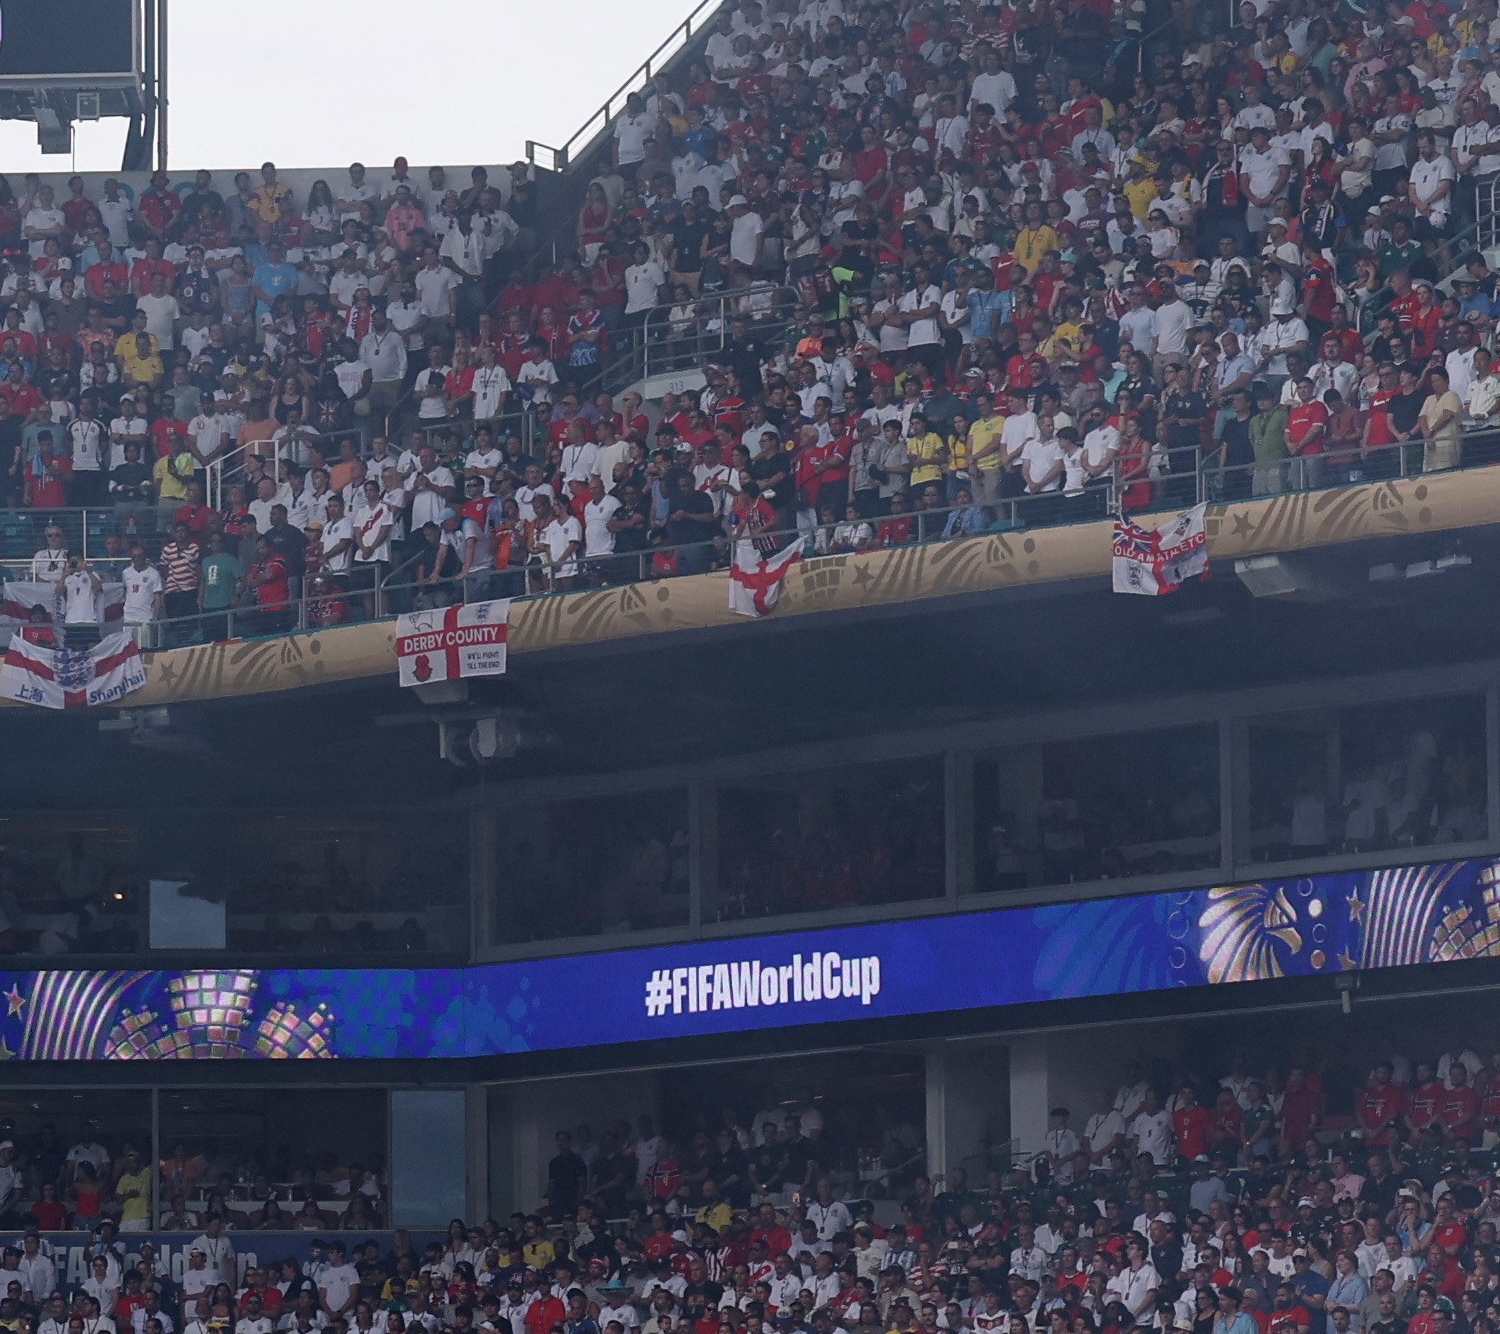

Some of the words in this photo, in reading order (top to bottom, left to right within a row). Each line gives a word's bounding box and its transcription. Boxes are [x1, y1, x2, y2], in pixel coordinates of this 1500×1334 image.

[1114, 545, 1155, 562] OLDAM
[1157, 533, 1205, 562] ATHETC
[404, 633, 444, 654] DERBY
[445, 627, 499, 646] COUNTY
[14, 683, 45, 702] 上海
[89, 670, 145, 704] Shanghai
[644, 951, 881, 1017] #FIFAWorldCup
